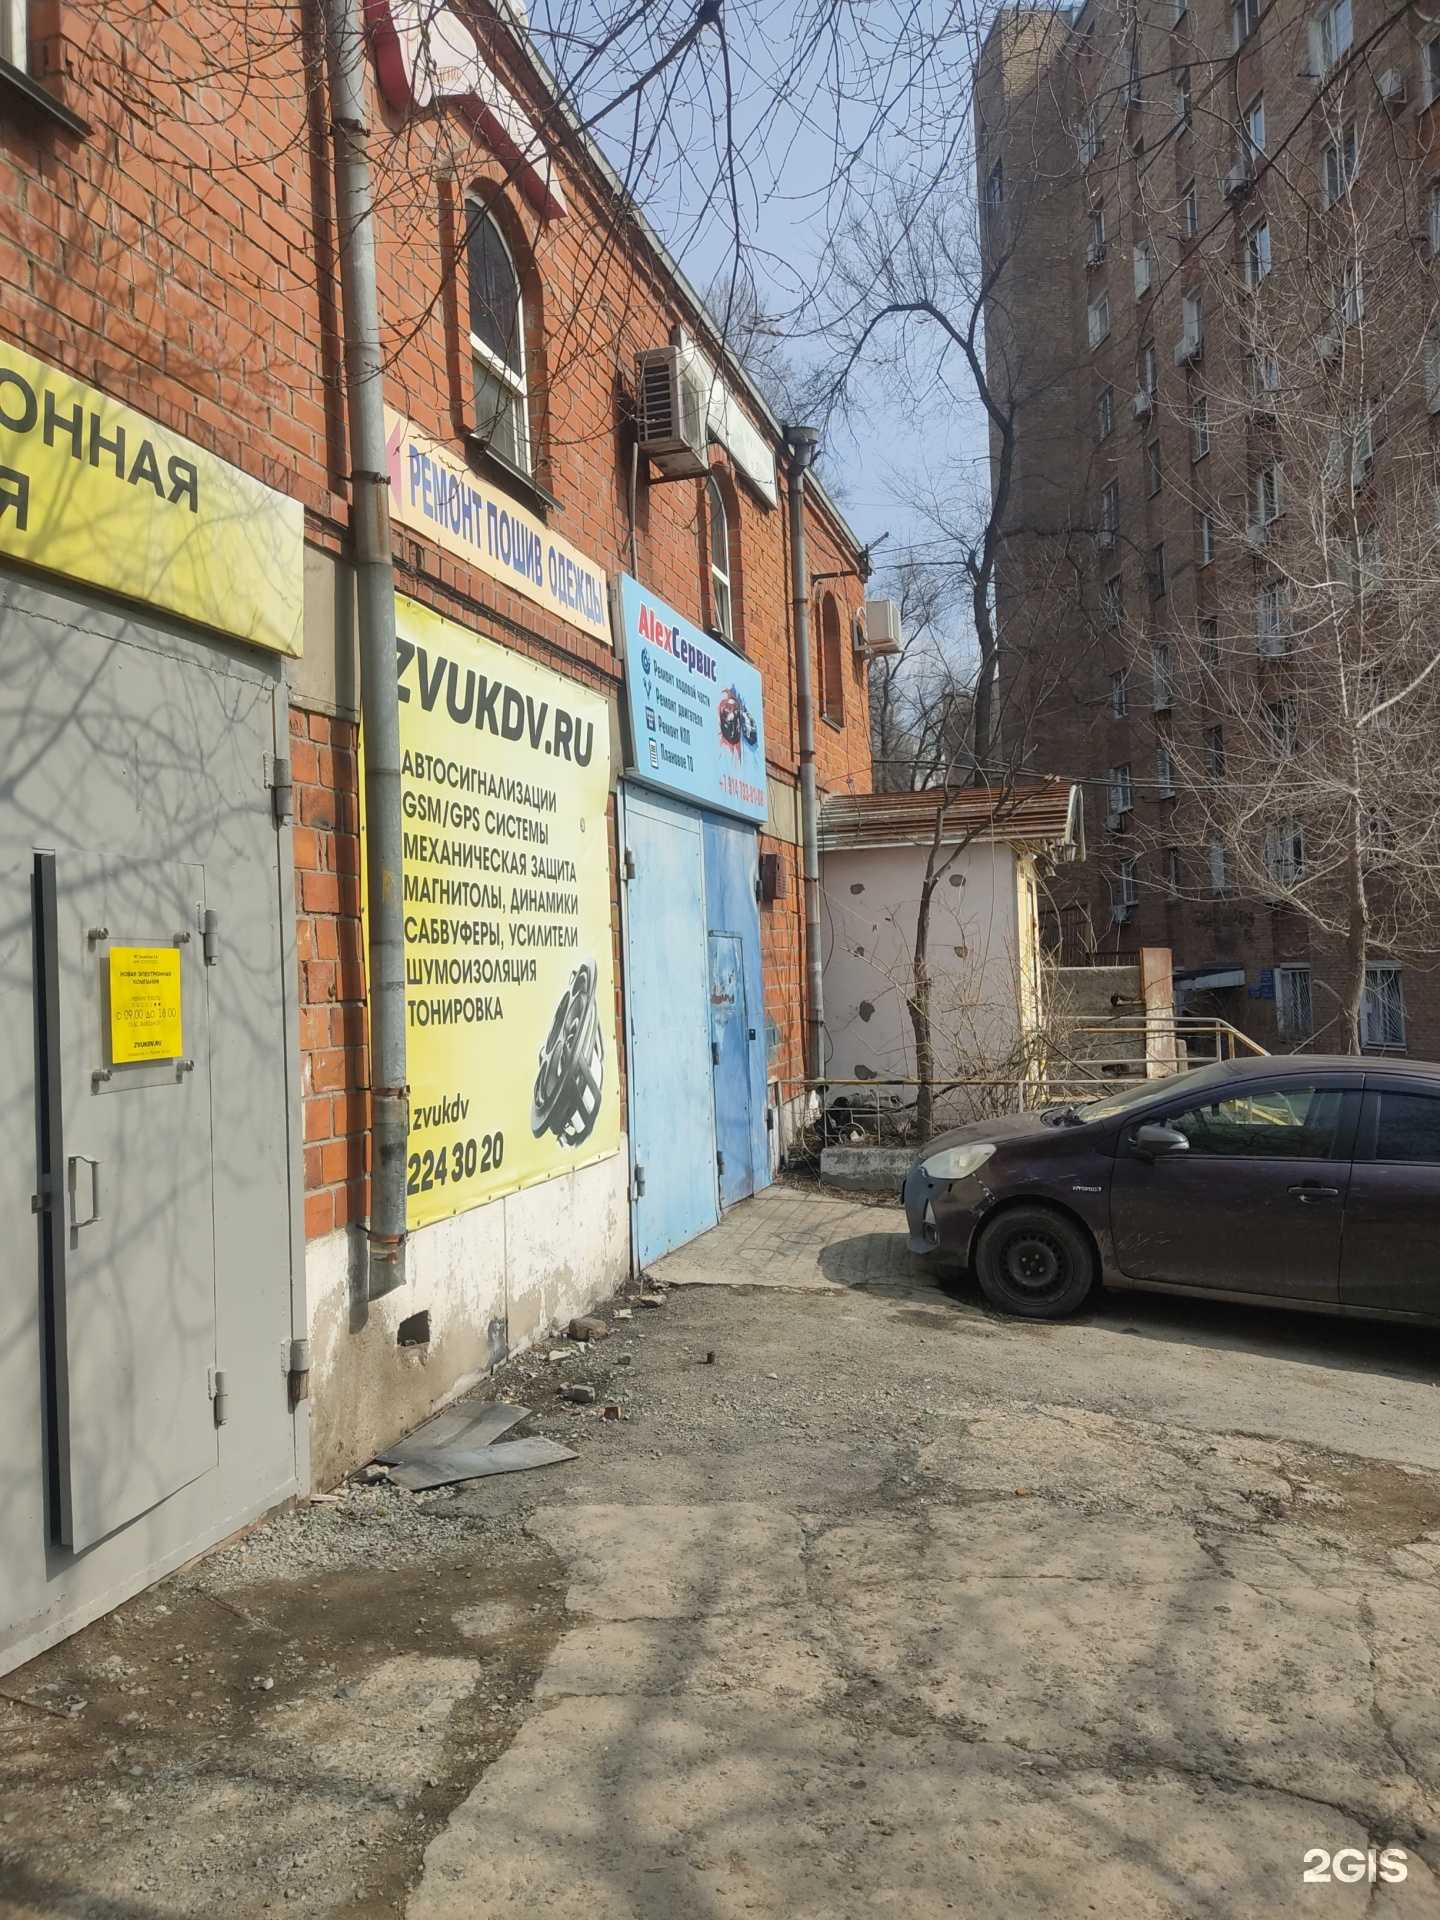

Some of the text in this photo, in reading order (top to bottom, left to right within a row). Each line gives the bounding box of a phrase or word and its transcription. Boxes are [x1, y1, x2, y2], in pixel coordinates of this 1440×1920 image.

[408, 443, 606, 628] РЕМОНТ ПОШИВ ОДЕЖДЫ
[653, 659, 675, 687] Ремонт
[396, 636, 594, 768] ZVUKDV.RU
[655, 687, 677, 713] Ремонт
[658, 714, 679, 741] Ремонт
[660, 743, 687, 769] Плановое
[401, 748, 557, 814] АВТОСИГНАЛИЗАЦИИ
[402, 790, 549, 845] GSM/GPS СИСТЕМЫ
[403, 832, 577, 884] МЕХАНИЧЕСКАЯ ЗАЩИТА
[403, 874, 579, 916] МАГНИТОЛЫ, ДИНАМИКИ
[404, 916, 578, 950] САБВУФЕРЫ, УСИЛИТЕЛИ
[406, 958, 537, 986] ШУМОИЗОЛЯЦИЯ
[407, 996, 504, 1027] ТОНИРОВКА
[412, 1093, 470, 1131] zvukdv
[406, 1131, 504, 1196] 224 30 20
